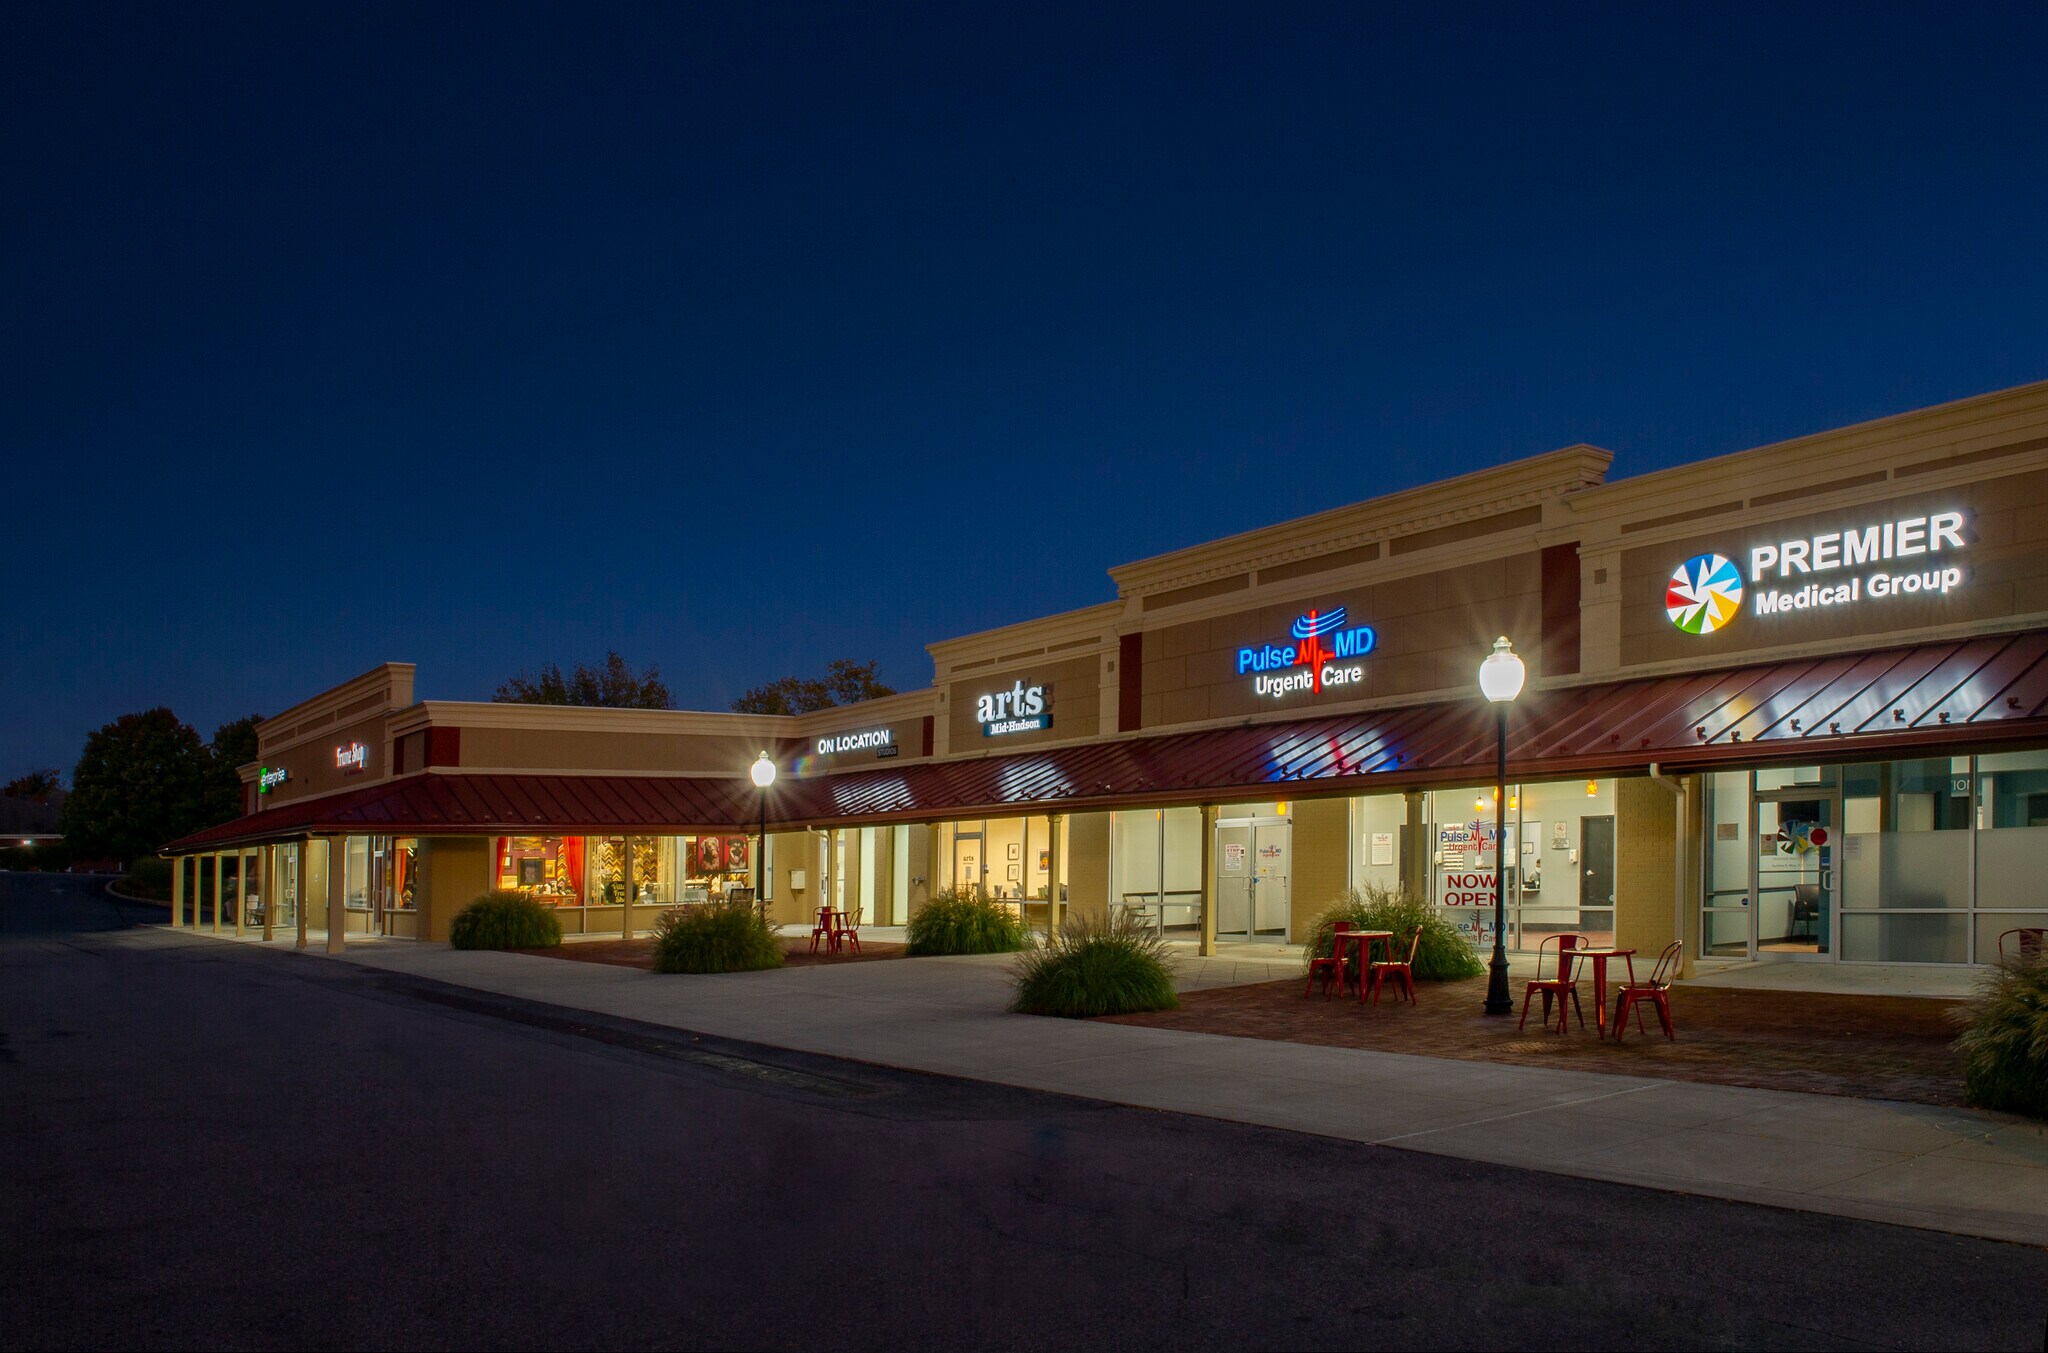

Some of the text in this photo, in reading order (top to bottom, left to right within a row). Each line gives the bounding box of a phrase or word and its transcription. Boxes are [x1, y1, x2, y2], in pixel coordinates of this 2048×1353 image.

[1751, 511, 1965, 582] PREMIER
[1756, 566, 1961, 615] Medical Group
[1239, 626, 1374, 674] Pulse MD
[1256, 666, 1362, 697] Urgent Care
[977, 680, 1043, 723] arts
[818, 729, 889, 755] ON LOCATION
[877, 747, 897, 757] STUDIOS
[261, 767, 285, 787] enterprise
[1440, 831, 1469, 842] Pulse
[1449, 842, 1498, 854] Urgent Car
